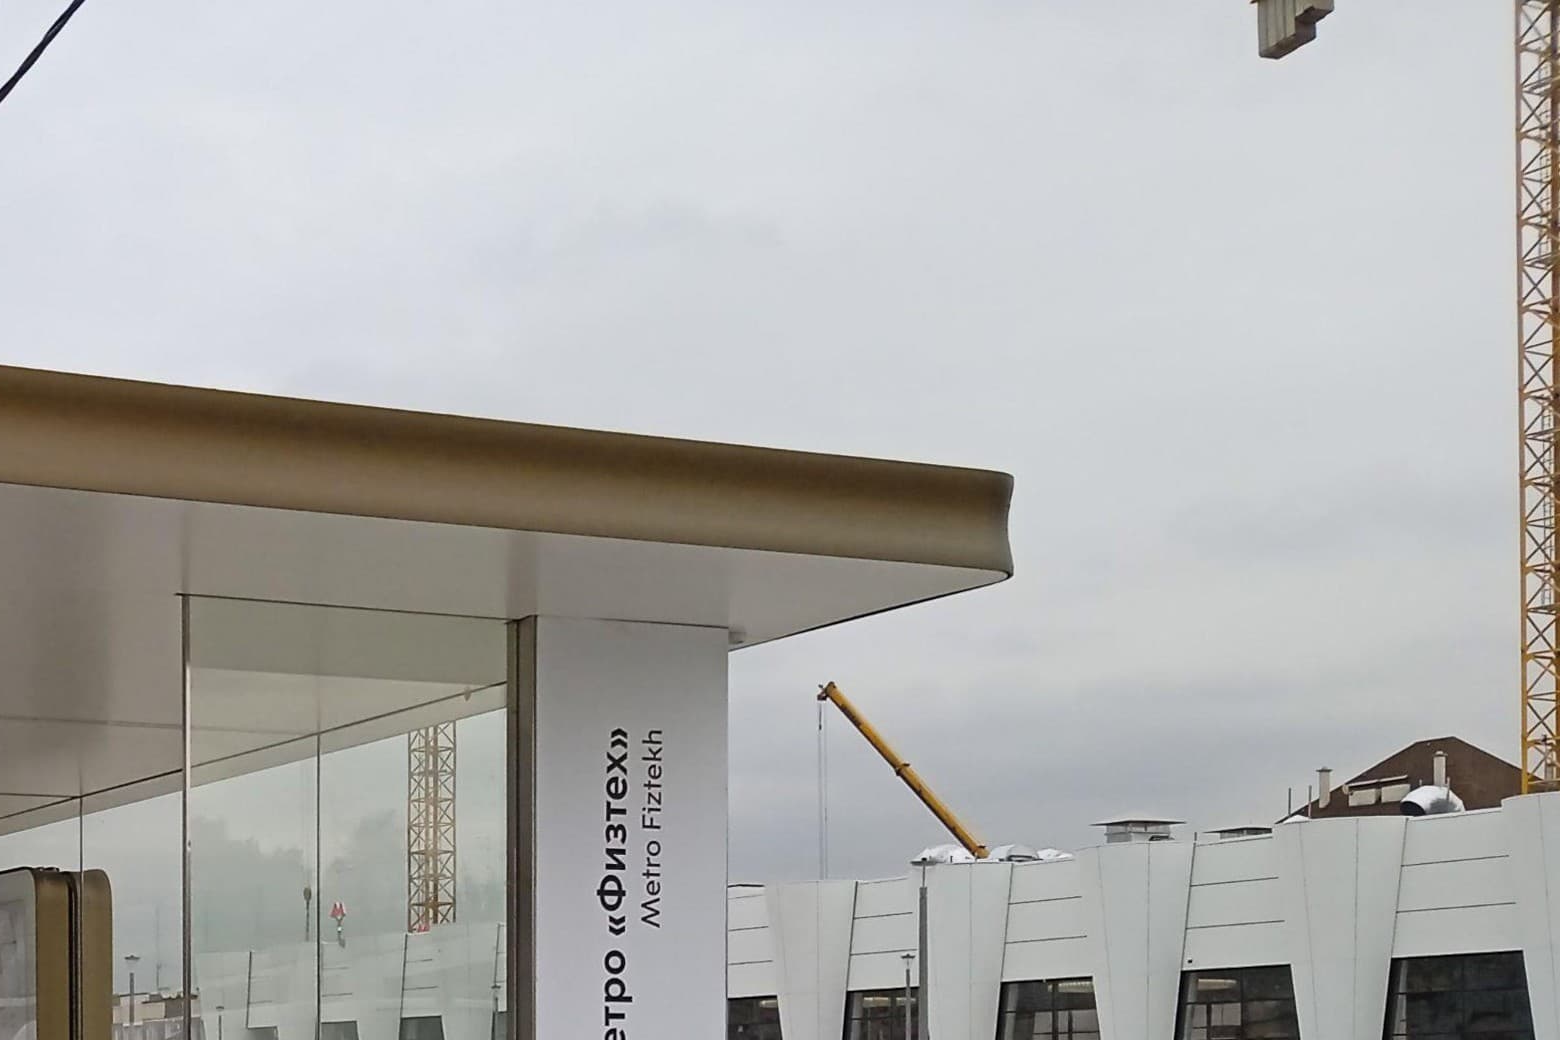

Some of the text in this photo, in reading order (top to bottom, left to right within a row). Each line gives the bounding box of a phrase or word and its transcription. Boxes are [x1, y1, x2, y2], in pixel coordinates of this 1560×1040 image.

[596, 727, 628, 936] «Физтех»
[640, 729, 663, 929] Metro Fiztekh
